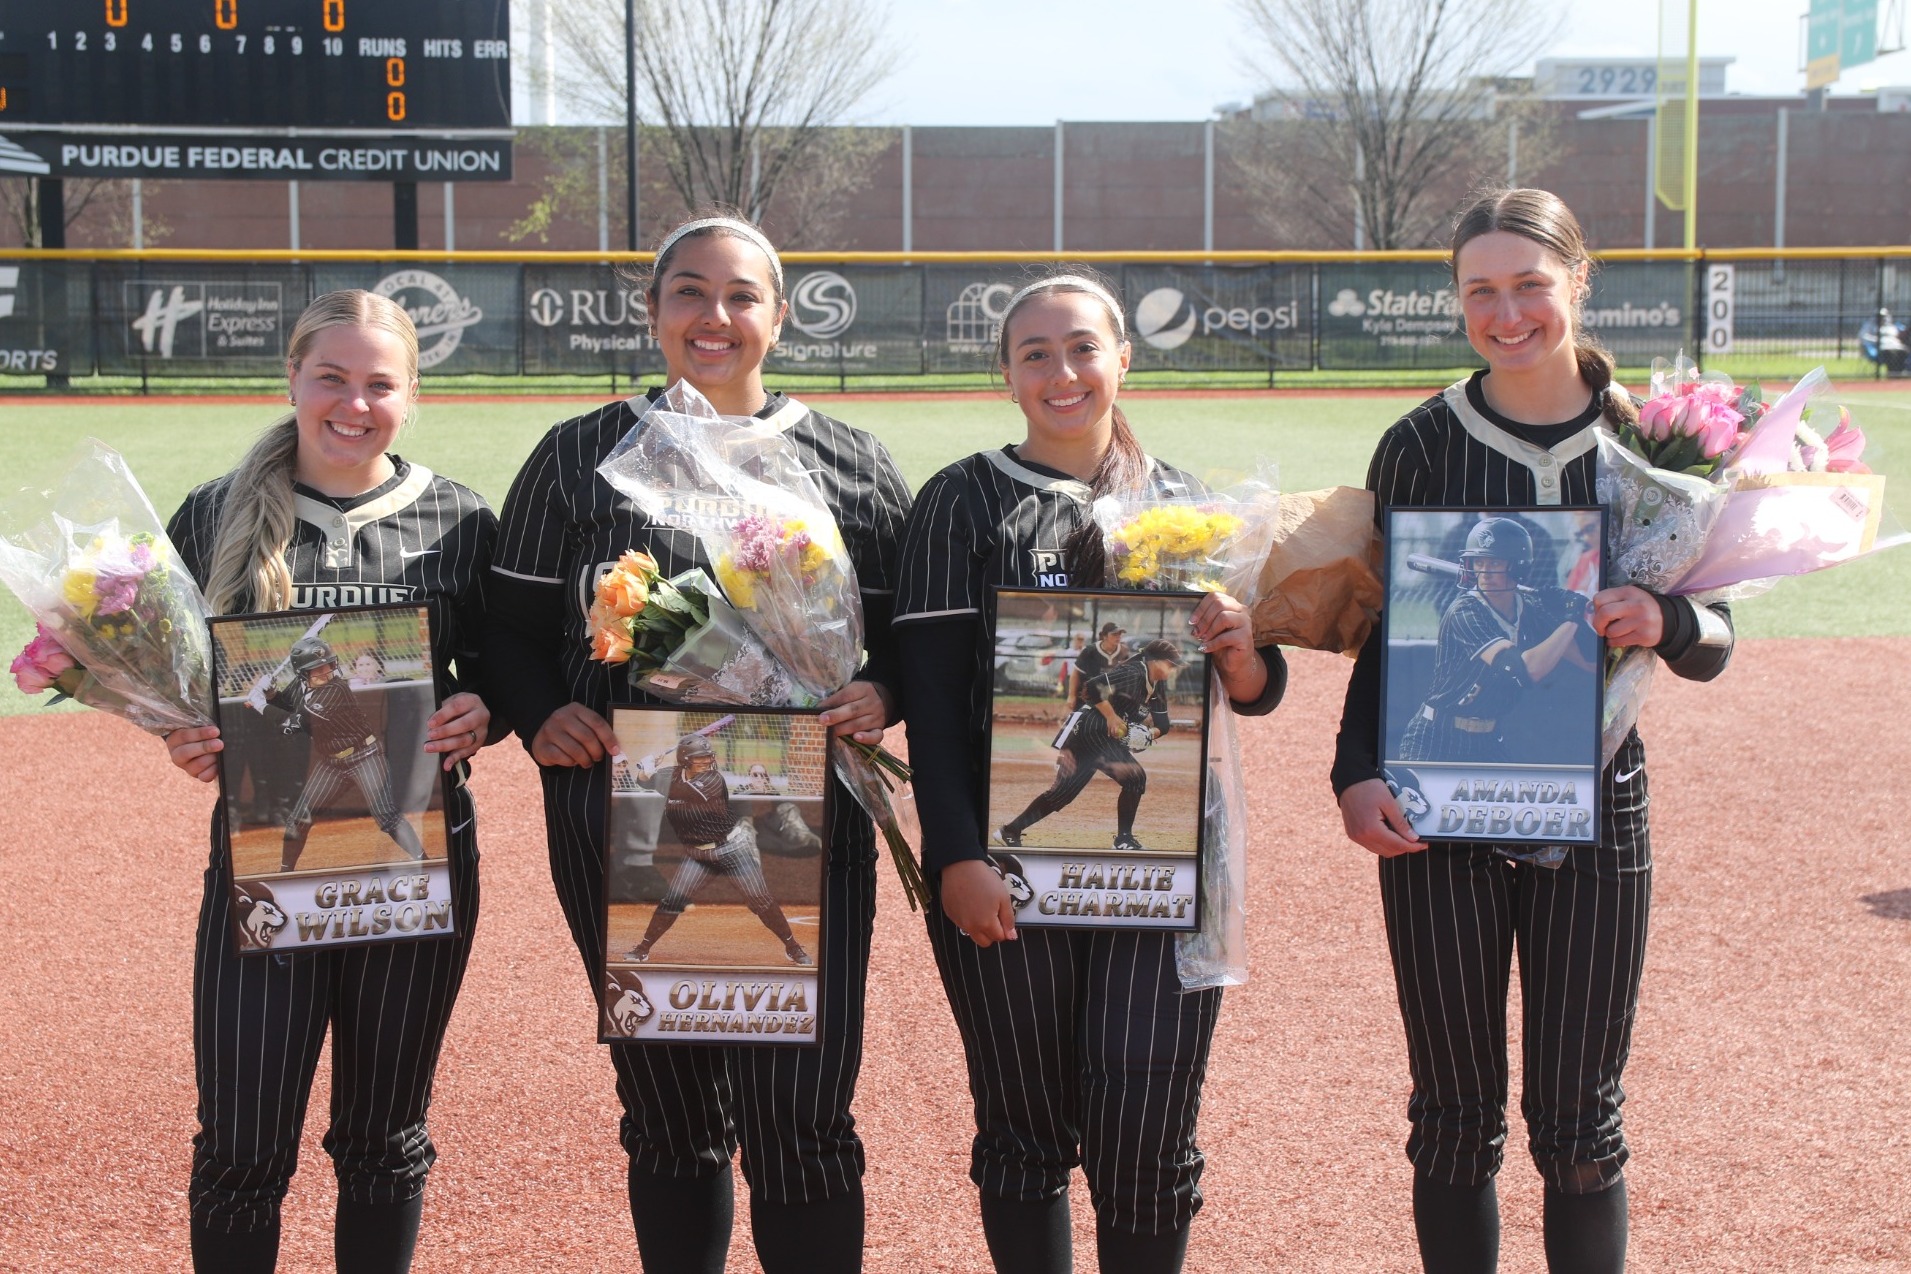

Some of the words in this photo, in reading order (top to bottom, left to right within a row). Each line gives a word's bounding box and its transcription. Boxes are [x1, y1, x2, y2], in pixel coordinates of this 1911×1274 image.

[47, 31, 57, 50] 1
[75, 31, 87, 50] 2
[104, 32, 117, 51] 3
[141, 33, 153, 52] 4
[170, 33, 182, 53] 5
[199, 34, 211, 54] 6
[235, 35, 247, 54] 7
[264, 35, 275, 55] 8
[291, 36, 303, 55] 9
[322, 37, 343, 56] 10
[358, 38, 407, 57] RUNS
[423, 39, 463, 58] HITS
[473, 40, 509, 59] ERR
[386, 57, 405, 87] 0
[1578, 66, 1658, 94] 2929
[387, 91, 406, 121] 0
[62, 145, 180, 167] PURDUE
[188, 147, 313, 170] FEDERAL
[318, 148, 408, 171] CREDIT
[414, 150, 500, 172] UNION
[207, 295, 257, 315] Holiday
[257, 296, 278, 311] Inn
[570, 289, 649, 326] RUS
[1367, 289, 1464, 316] StateFa
[1583, 301, 1680, 327] omino's
[1712, 271, 1729, 349] 200
[207, 313, 276, 336] Express
[1203, 300, 1298, 336] pepsi
[229, 335, 266, 348] Suites
[569, 333, 641, 354] Physical
[773, 340, 878, 362] Signature
[291, 585, 409, 609] URDUE
[1450, 778, 1579, 805] AMANDA
[1436, 804, 1592, 838] DEBOER
[1057, 862, 1176, 892] HAILIE
[314, 873, 431, 910] GRACE
[1037, 890, 1193, 919] CHARMAT
[294, 899, 452, 943] WILSON
[669, 979, 809, 1013] OLIVIA
[657, 1011, 816, 1035] HERNANDEZ
